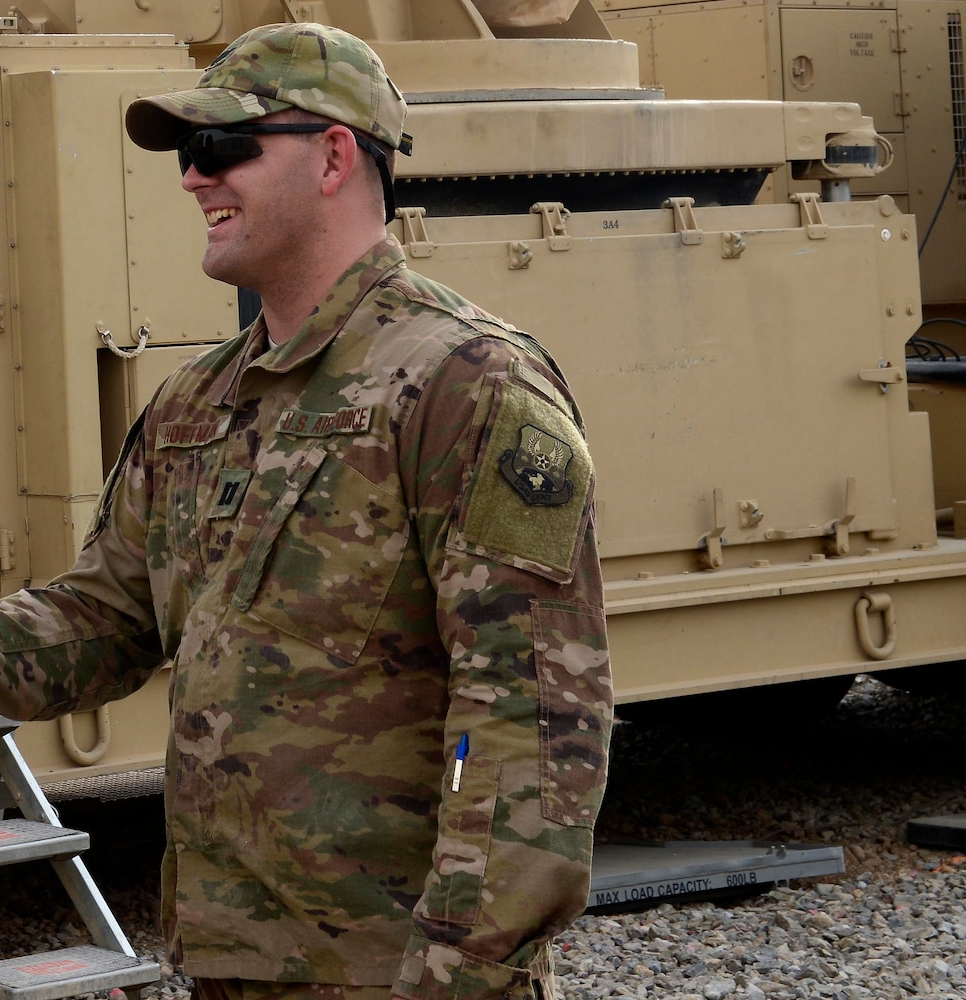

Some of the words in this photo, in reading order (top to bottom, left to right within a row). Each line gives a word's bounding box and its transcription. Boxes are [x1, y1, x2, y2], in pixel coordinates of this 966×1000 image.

[603, 219, 619, 230] 3A4
[282, 412, 309, 433] U.S.
[311, 415, 334, 433] AIR
[334, 407, 368, 430] ORCE
[596, 890, 619, 905] MAX
[624, 886, 654, 901] LOAD
[657, 879, 712, 897] CAPACITY:
[726, 872, 757, 887] 600LB
